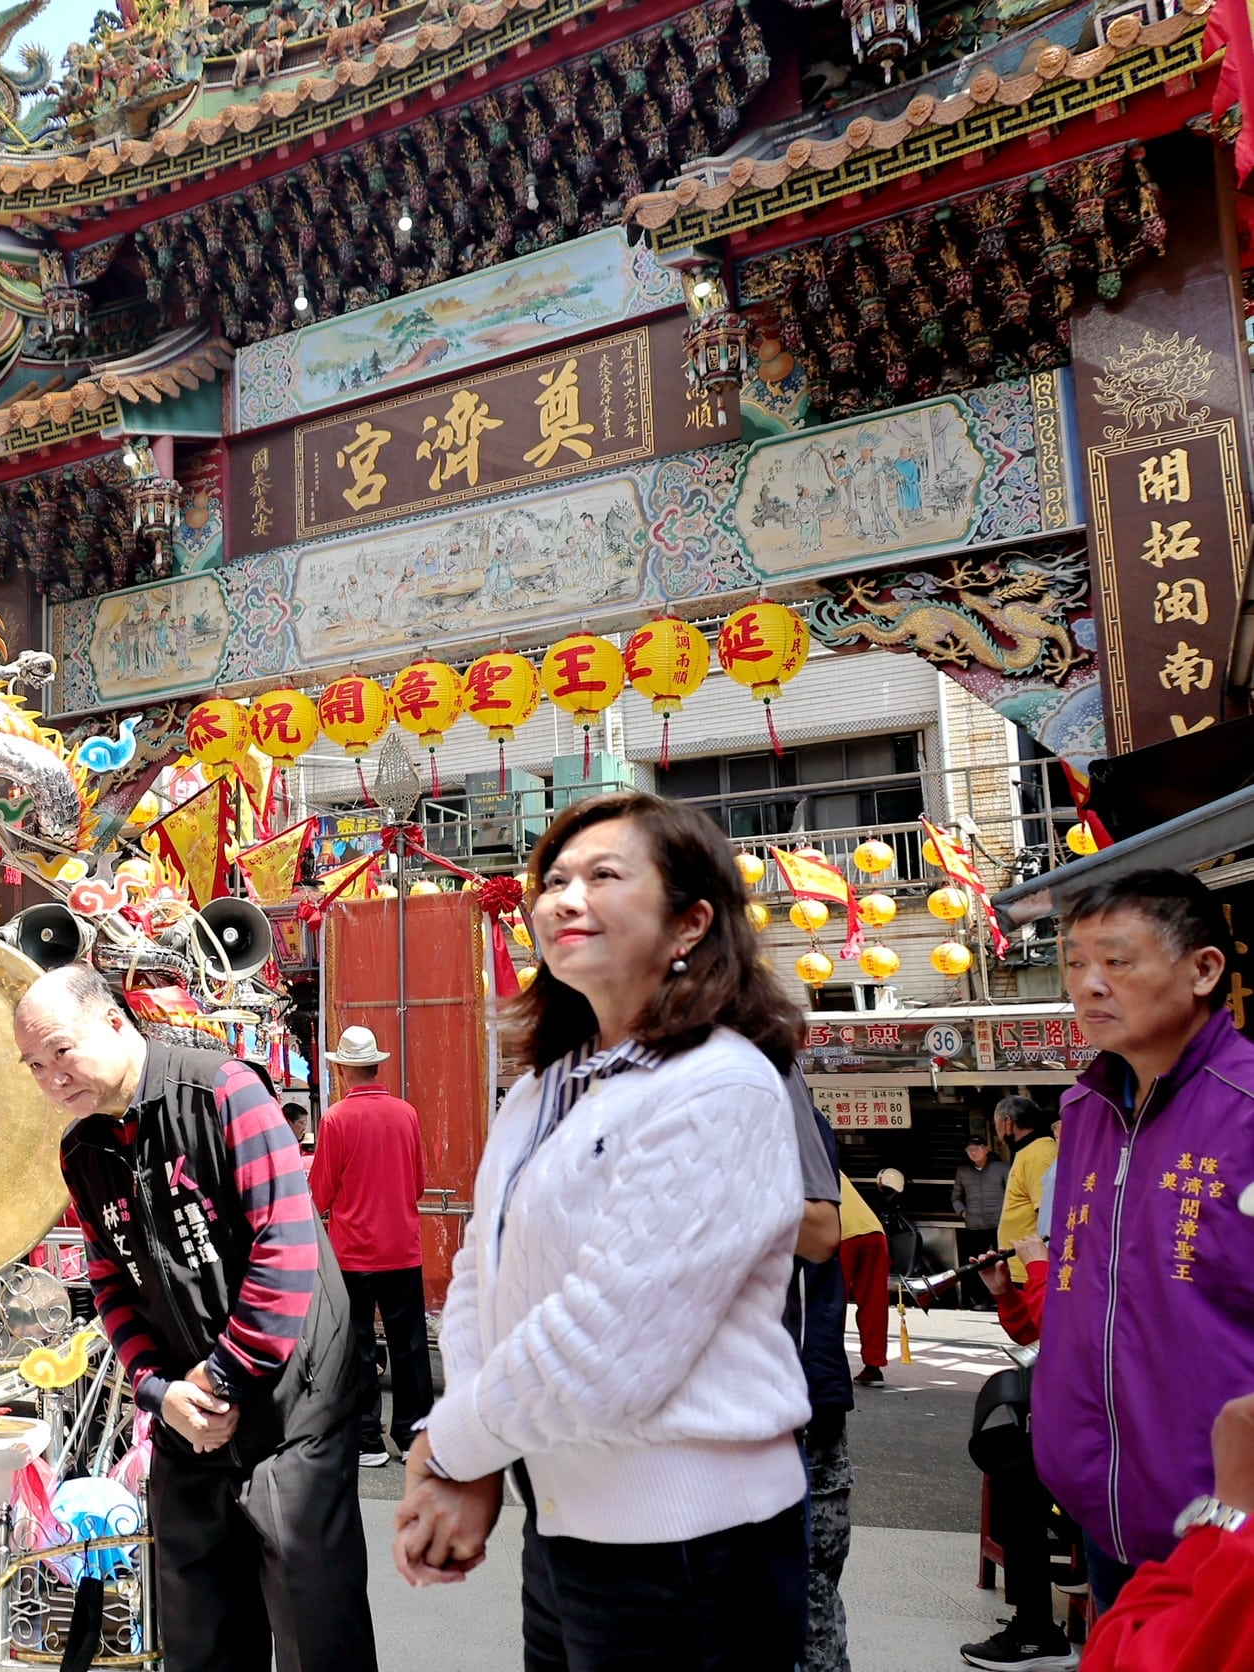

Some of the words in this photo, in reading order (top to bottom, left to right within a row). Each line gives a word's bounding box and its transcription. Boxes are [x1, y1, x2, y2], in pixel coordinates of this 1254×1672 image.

[618, 342, 639, 439] 道曆四六九五年
[336, 357, 594, 512] 奠濟宮
[249, 447, 274, 537] 國泰民安
[672, 623, 691, 685] 風調雨順
[933, 1031, 955, 1051] 36
[835, 1102, 888, 1113] 蚵仔煎
[890, 1103, 902, 1113] 80
[836, 1115, 889, 1126] 蚵仔湯
[890, 1115, 903, 1126] 60
[1158, 1170, 1226, 1199] 奠濟宮
[1175, 1152, 1219, 1176] 基隆
[1170, 1198, 1201, 1283] 開漳聖王
